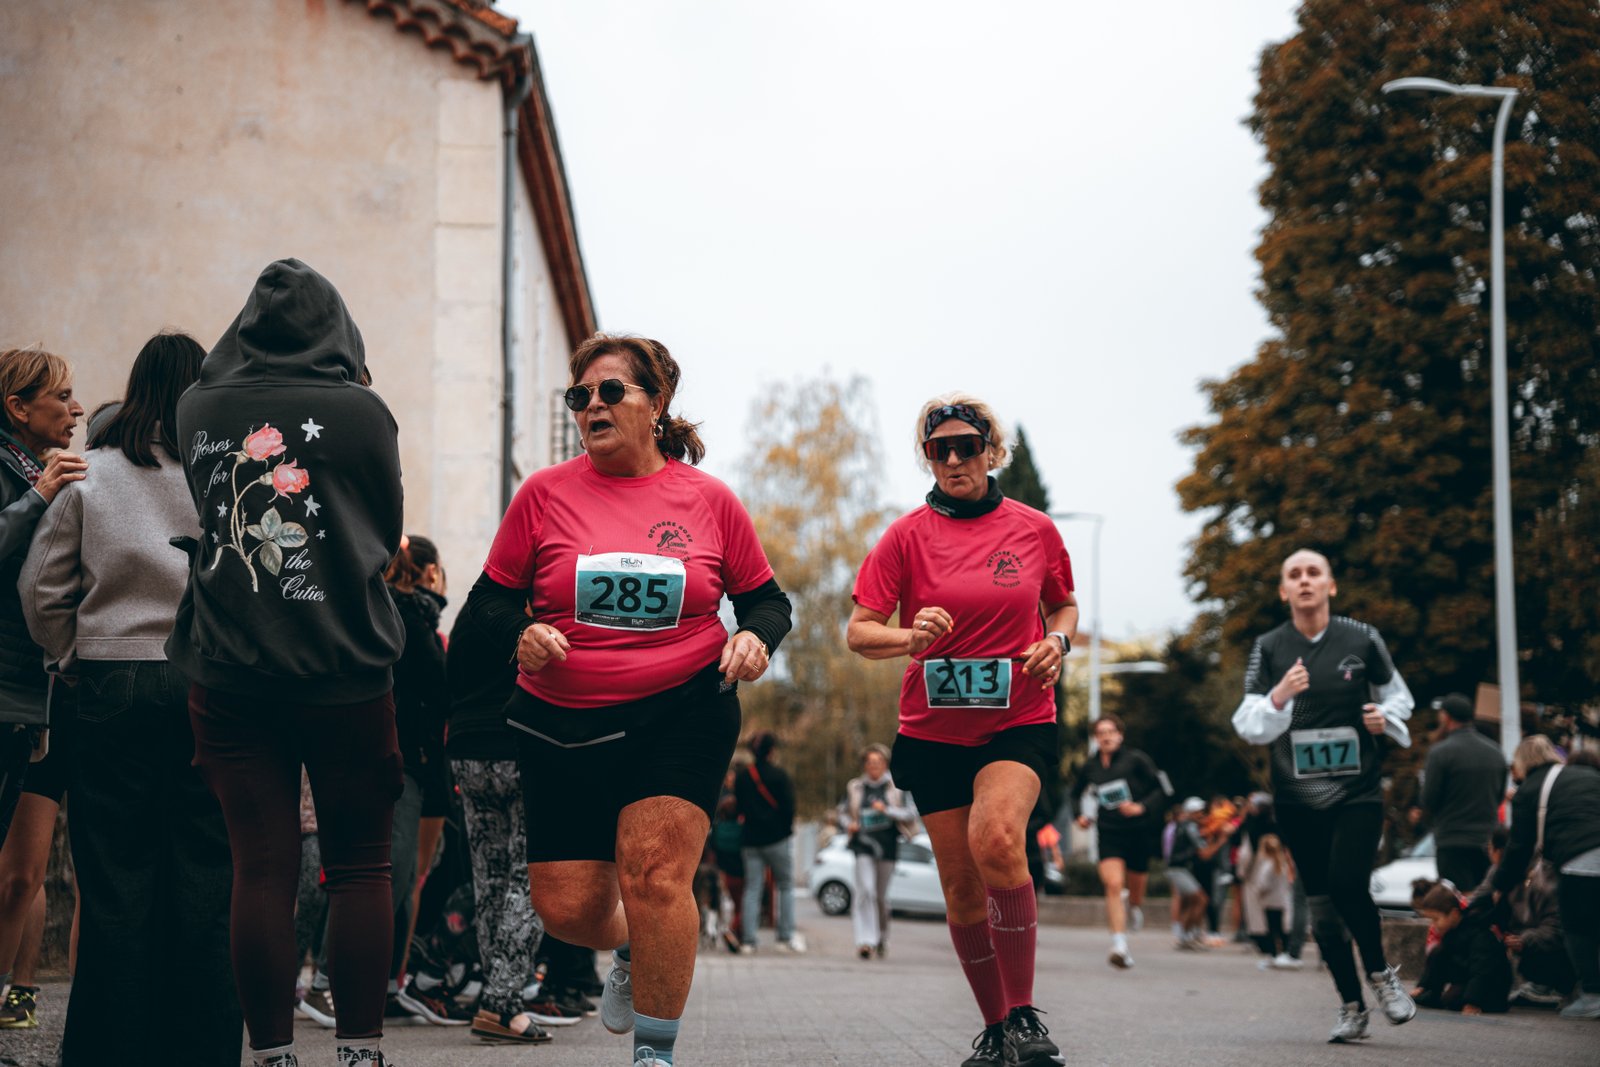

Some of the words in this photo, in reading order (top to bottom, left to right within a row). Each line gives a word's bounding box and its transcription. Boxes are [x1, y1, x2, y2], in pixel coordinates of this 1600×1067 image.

[191, 430, 234, 465] Roses
[204, 460, 231, 498] for
[647, 521, 676, 539] OCTOBRE
[678, 526, 693, 543] ROSE
[284, 548, 313, 570] the
[620, 557, 643, 565] RUN
[279, 573, 327, 602] Cuties
[589, 575, 669, 614] 285
[935, 664, 1000, 695] 213
[1303, 742, 1350, 767] 117
